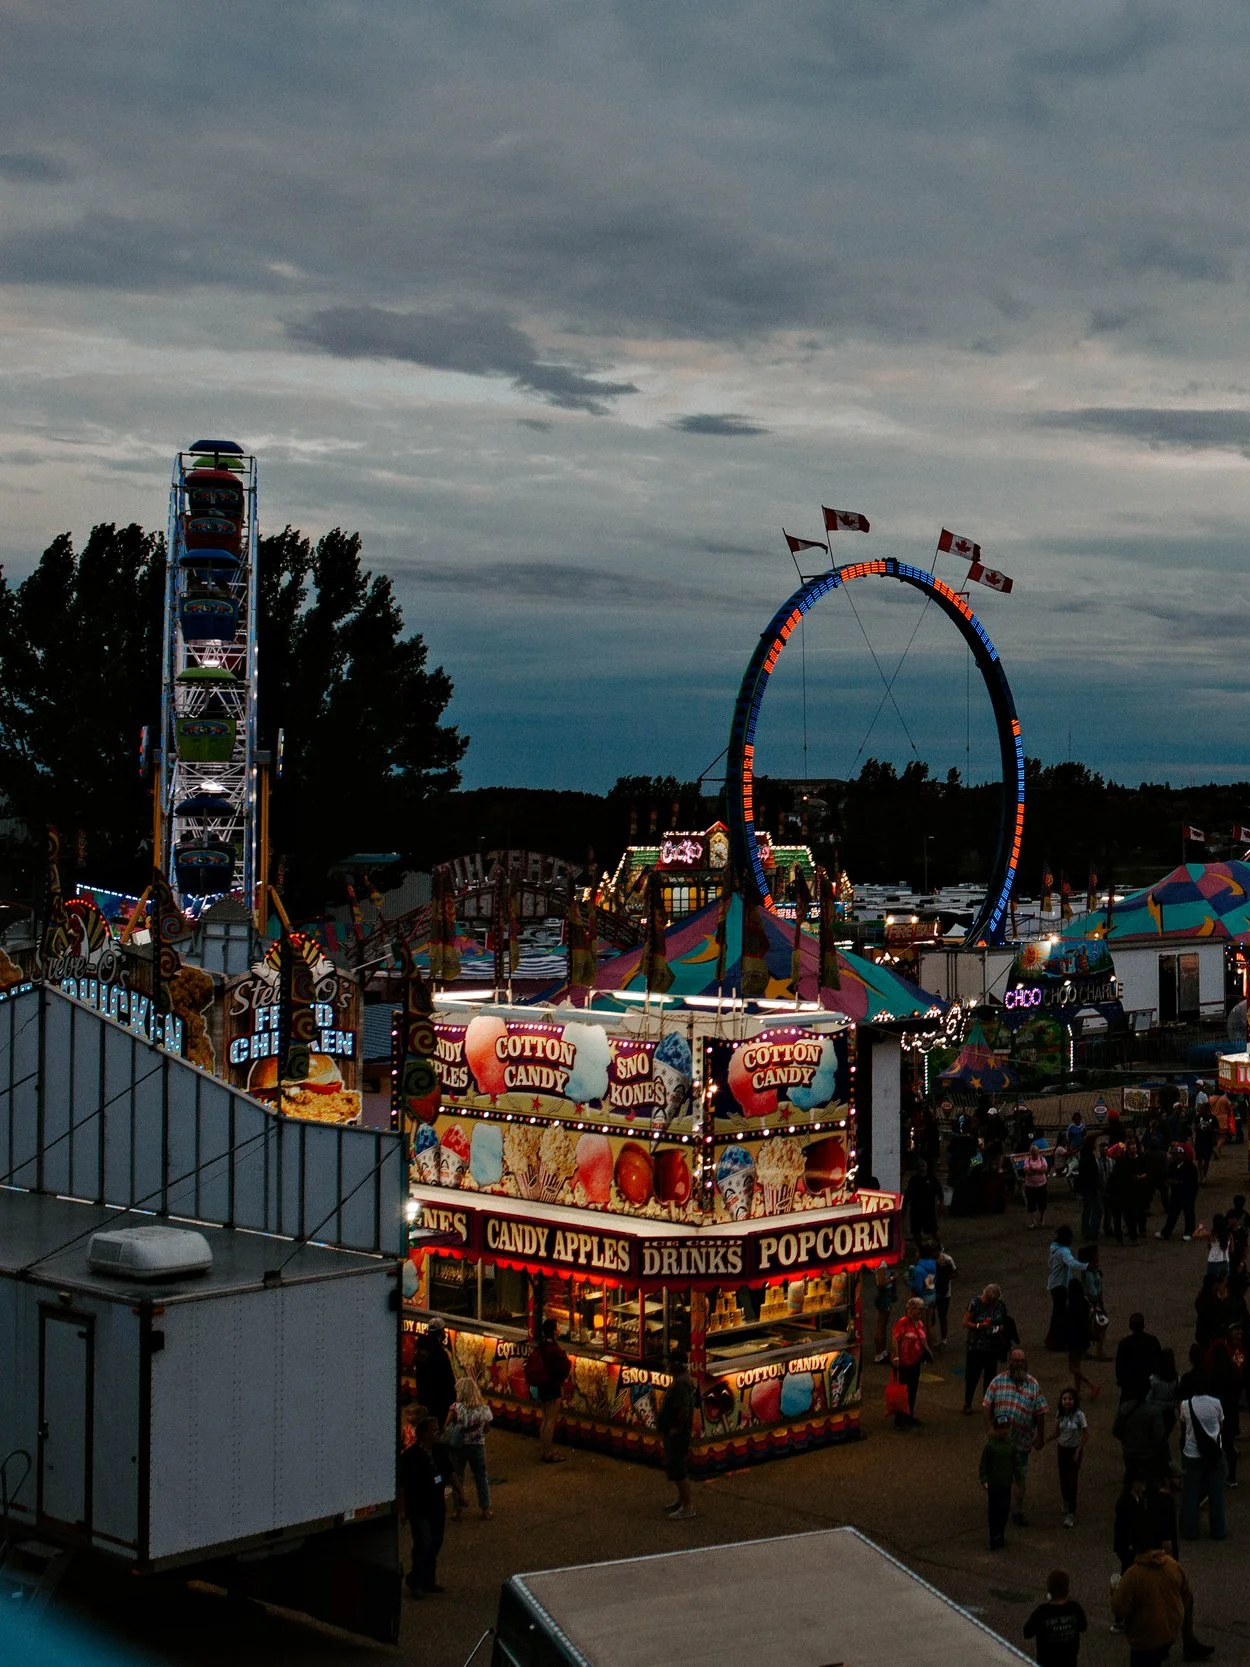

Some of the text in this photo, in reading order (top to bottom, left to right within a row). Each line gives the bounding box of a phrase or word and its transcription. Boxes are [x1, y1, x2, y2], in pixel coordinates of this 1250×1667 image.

[1005, 987, 1042, 1010] CHOO
[229, 1029, 354, 1065] CHIEN
[434, 1037, 464, 1063] NDY
[496, 1036, 575, 1068] COTTON
[743, 1043, 822, 1071] COTTON
[505, 1065, 569, 1093] CANDY
[617, 1052, 650, 1080] SNO
[752, 1066, 815, 1092] CANDY
[611, 1081, 666, 1109] KONES
[421, 1209, 467, 1242] NES
[487, 1217, 633, 1275] CANDY APPLES
[643, 1239, 744, 1248] ICE COLD
[758, 1218, 893, 1270] POPCORN
[642, 1246, 744, 1276] DRINKS
[621, 1367, 648, 1387] SNO
[737, 1354, 829, 1389] COTTON CANDY
